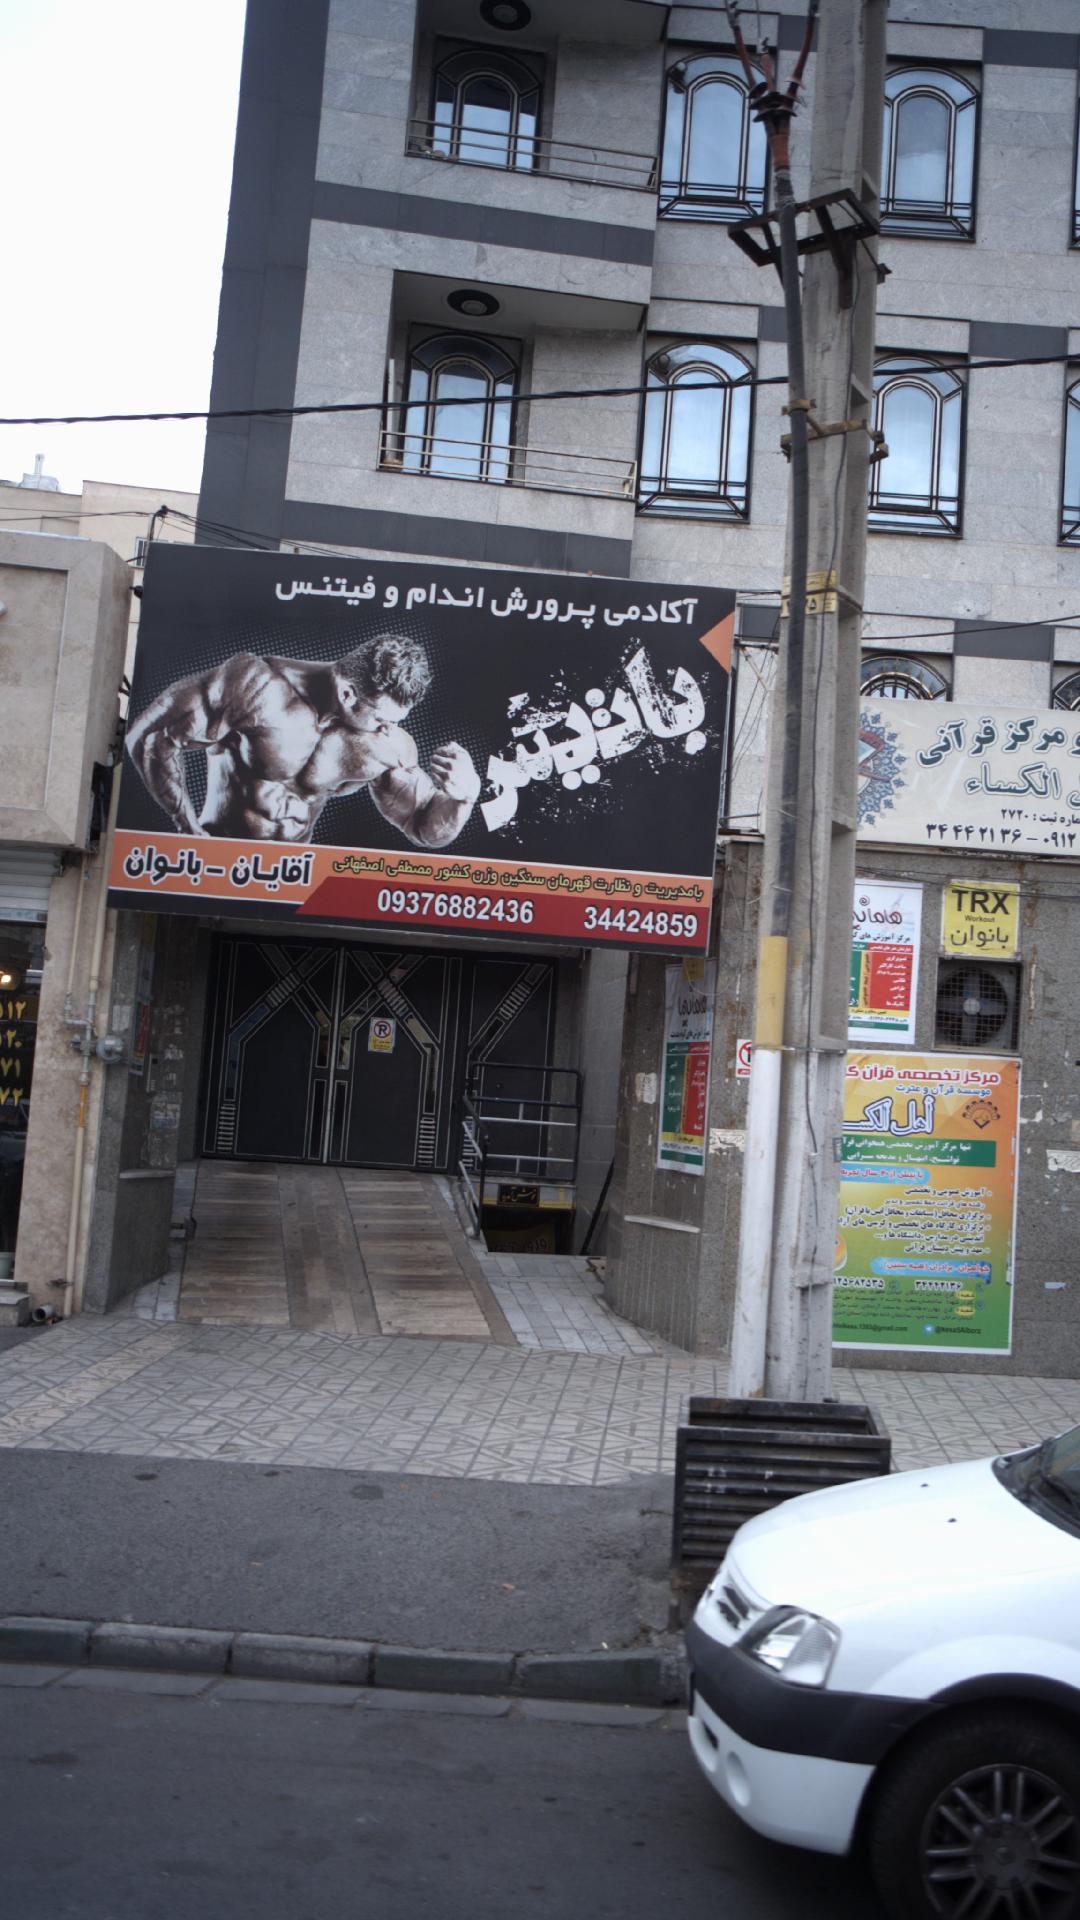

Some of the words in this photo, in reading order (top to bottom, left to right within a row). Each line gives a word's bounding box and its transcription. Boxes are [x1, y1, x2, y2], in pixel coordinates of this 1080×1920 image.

[275, 575, 376, 606] فیتنس
[383, 585, 399, 608] و
[406, 583, 484, 609] اندام
[490, 587, 596, 630] پرورش
[603, 598, 699, 627] آکادمی
[918, 718, 997, 767] قرآنی
[1002, 718, 1066, 751] مرکز
[966, 762, 1061, 798] الکساء
[1001, 809, 1029, 820] ۲۷۲۰
[125, 847, 202, 885] بانوان
[230, 852, 315, 892] آقایان
[333, 855, 385, 873] اصفهانی
[386, 859, 433, 876] مصطفی
[434, 863, 471, 881] کشور
[471, 867, 498, 885] وزن
[501, 868, 545, 887] سنگین
[547, 874, 592, 891] قهرمان
[594, 878, 631, 895] نظارت
[633, 881, 642, 896] و
[645, 884, 704, 900] بامدیریت
[377, 888, 534, 924] 09376882436
[951, 889, 1010, 915] TRX
[584, 906, 698, 938] 34424859
[964, 914, 996, 923] Workout
[950, 924, 1009, 949] بانوان
[862, 1066, 894, 1081] قرآن
[897, 1069, 960, 1082] تخصصی
[962, 1070, 1000, 1085] مرکز
[895, 1084, 921, 1094] عترت
[923, 1086, 930, 1095] و
[931, 1084, 955, 1096] قرآن
[956, 1088, 991, 1097] موسسه
[842, 1096, 894, 1133] الکس
[841, 1137, 854, 1147] قرآ
[886, 1141, 913, 1149] تخصصی
[915, 1140, 939, 1151] آموزش
[941, 1141, 957, 1151] مرکز
[959, 1142, 972, 1151] تنها
[862, 1168, 878, 1177] سال
[905, 1187, 931, 1195] تخصصی
[961, 1187, 985, 1197] آموزش
[959, 1212, 984, 1221] برگزاری
[958, 1223, 984, 1232] برگزاری
